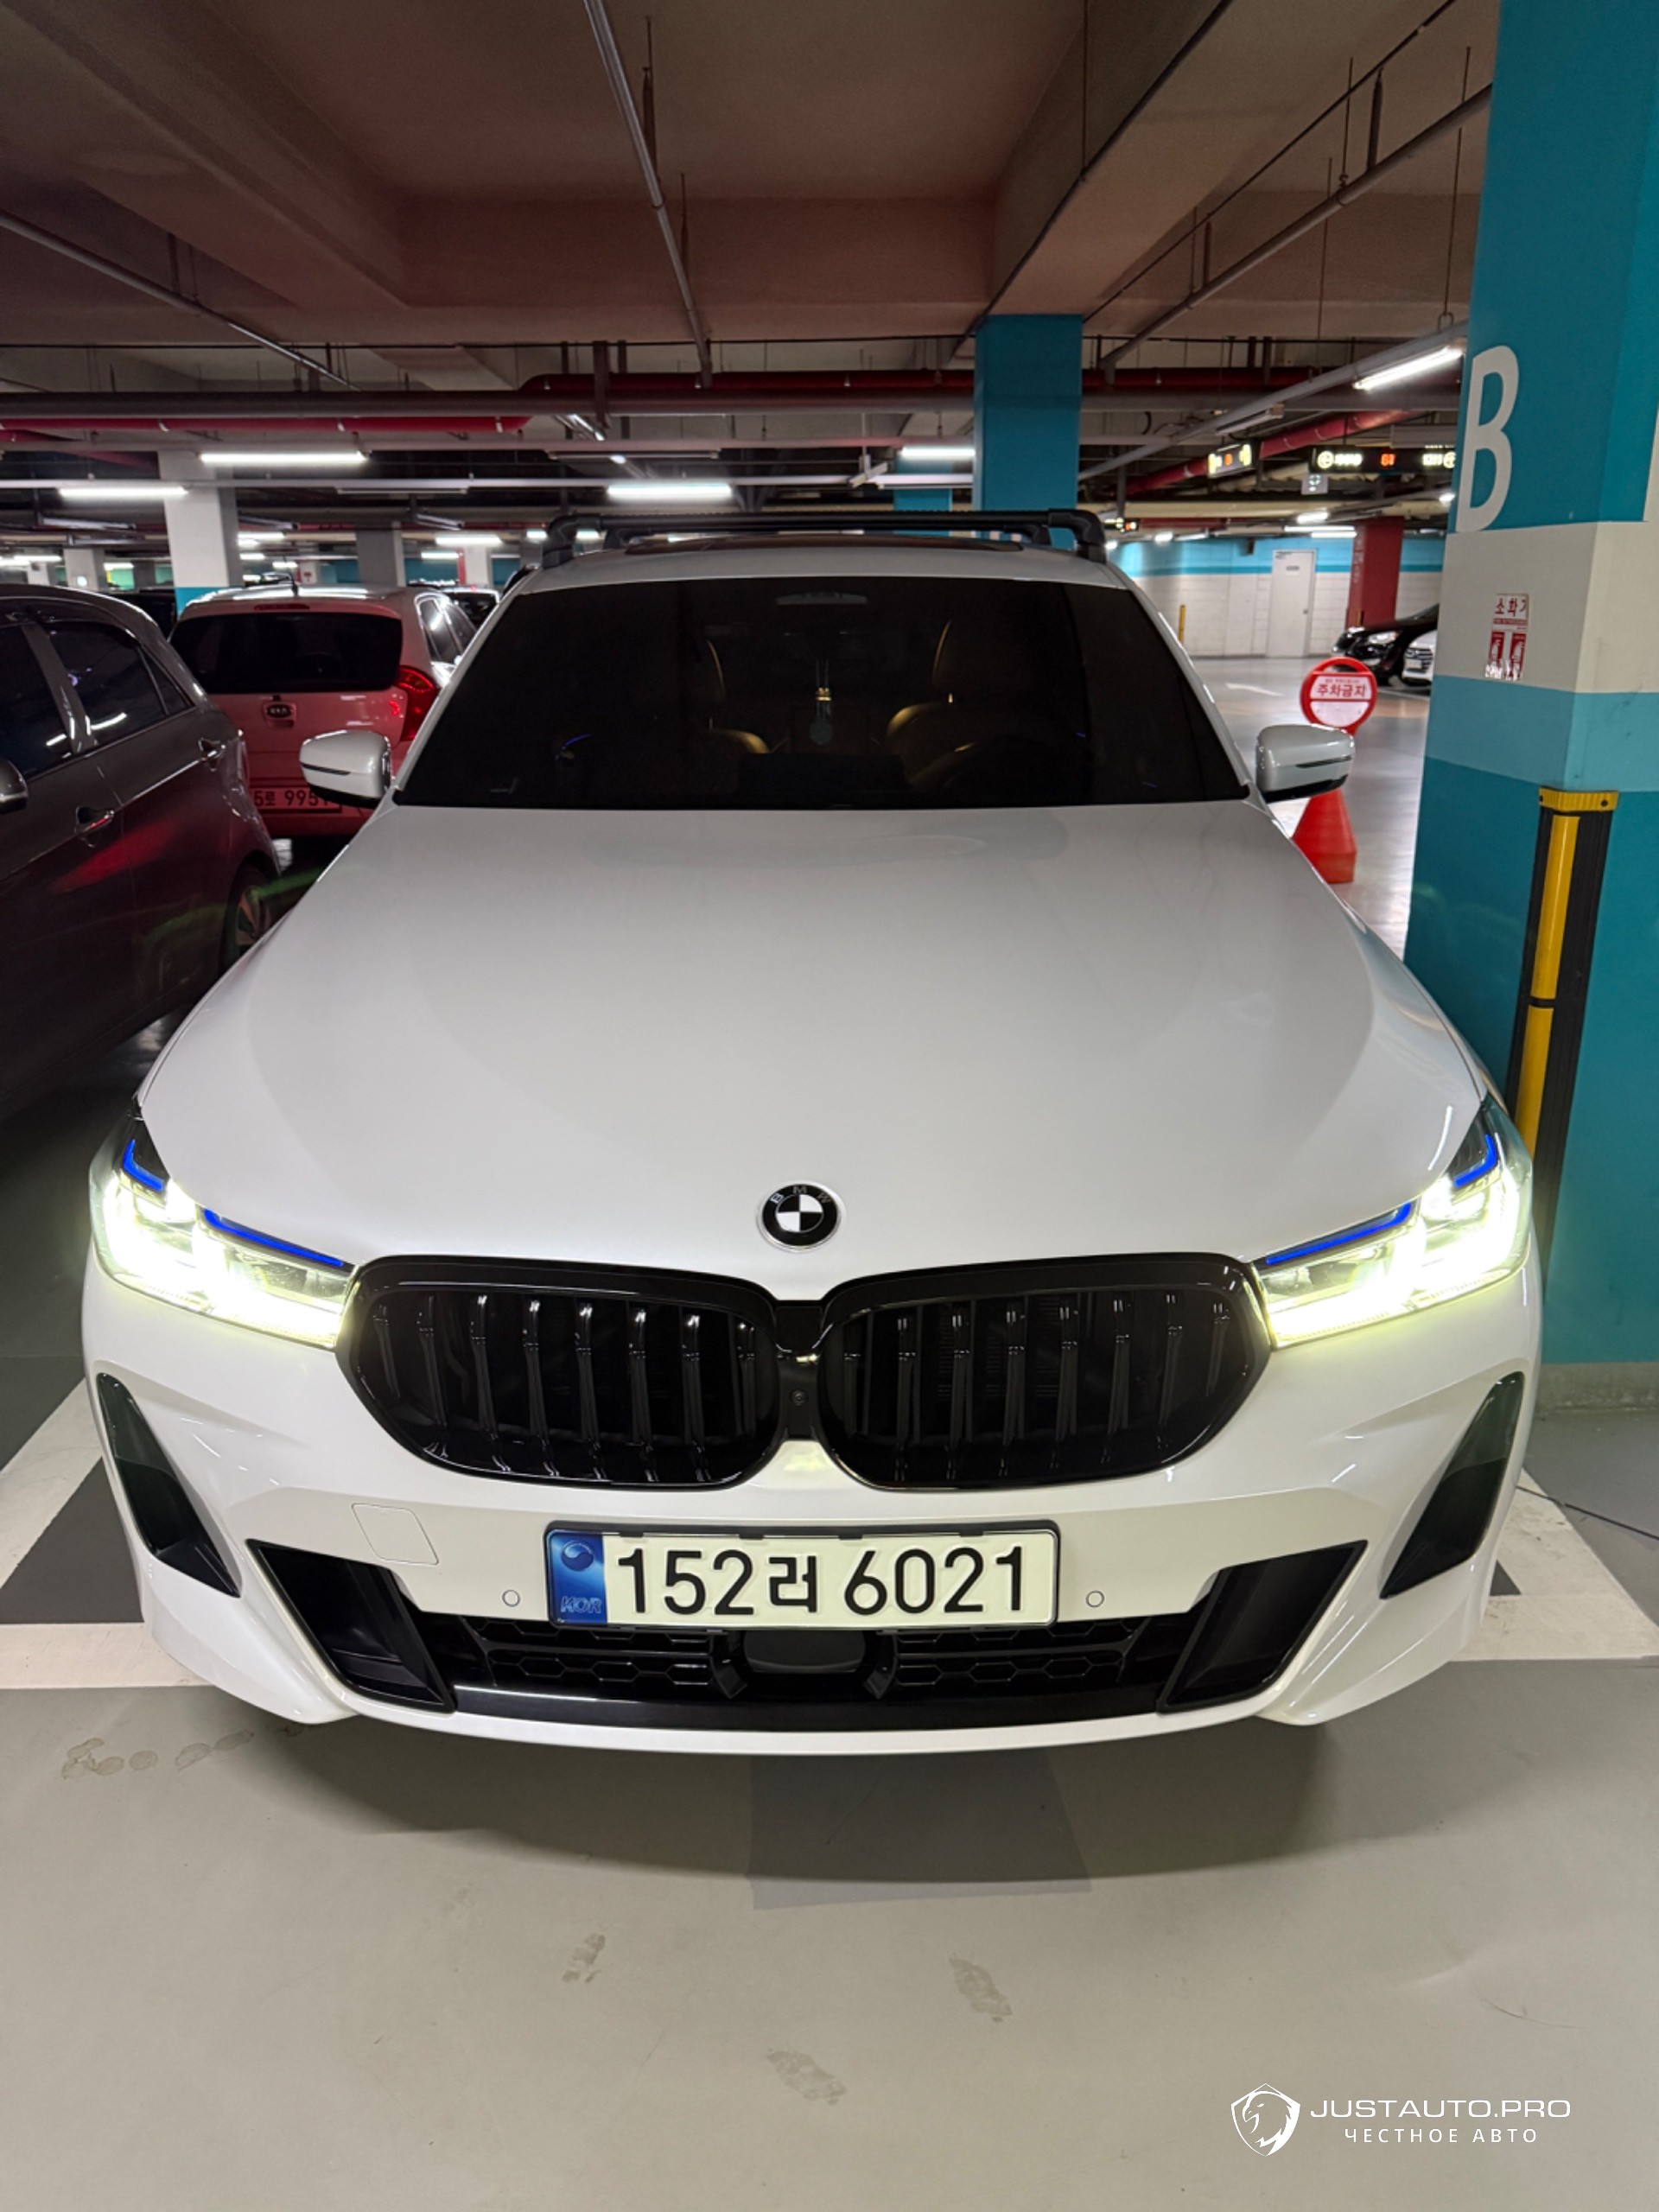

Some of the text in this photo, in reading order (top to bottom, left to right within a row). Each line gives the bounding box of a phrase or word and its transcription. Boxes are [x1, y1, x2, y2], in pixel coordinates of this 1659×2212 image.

[1456, 346, 1519, 532] B
[1317, 684, 1366, 698] 주차금지
[284, 790, 328, 807] 995
[769, 1185, 832, 1204] BMW
[619, 1547, 1021, 1616] 152러 6021
[560, 1596, 602, 1614] KOR
